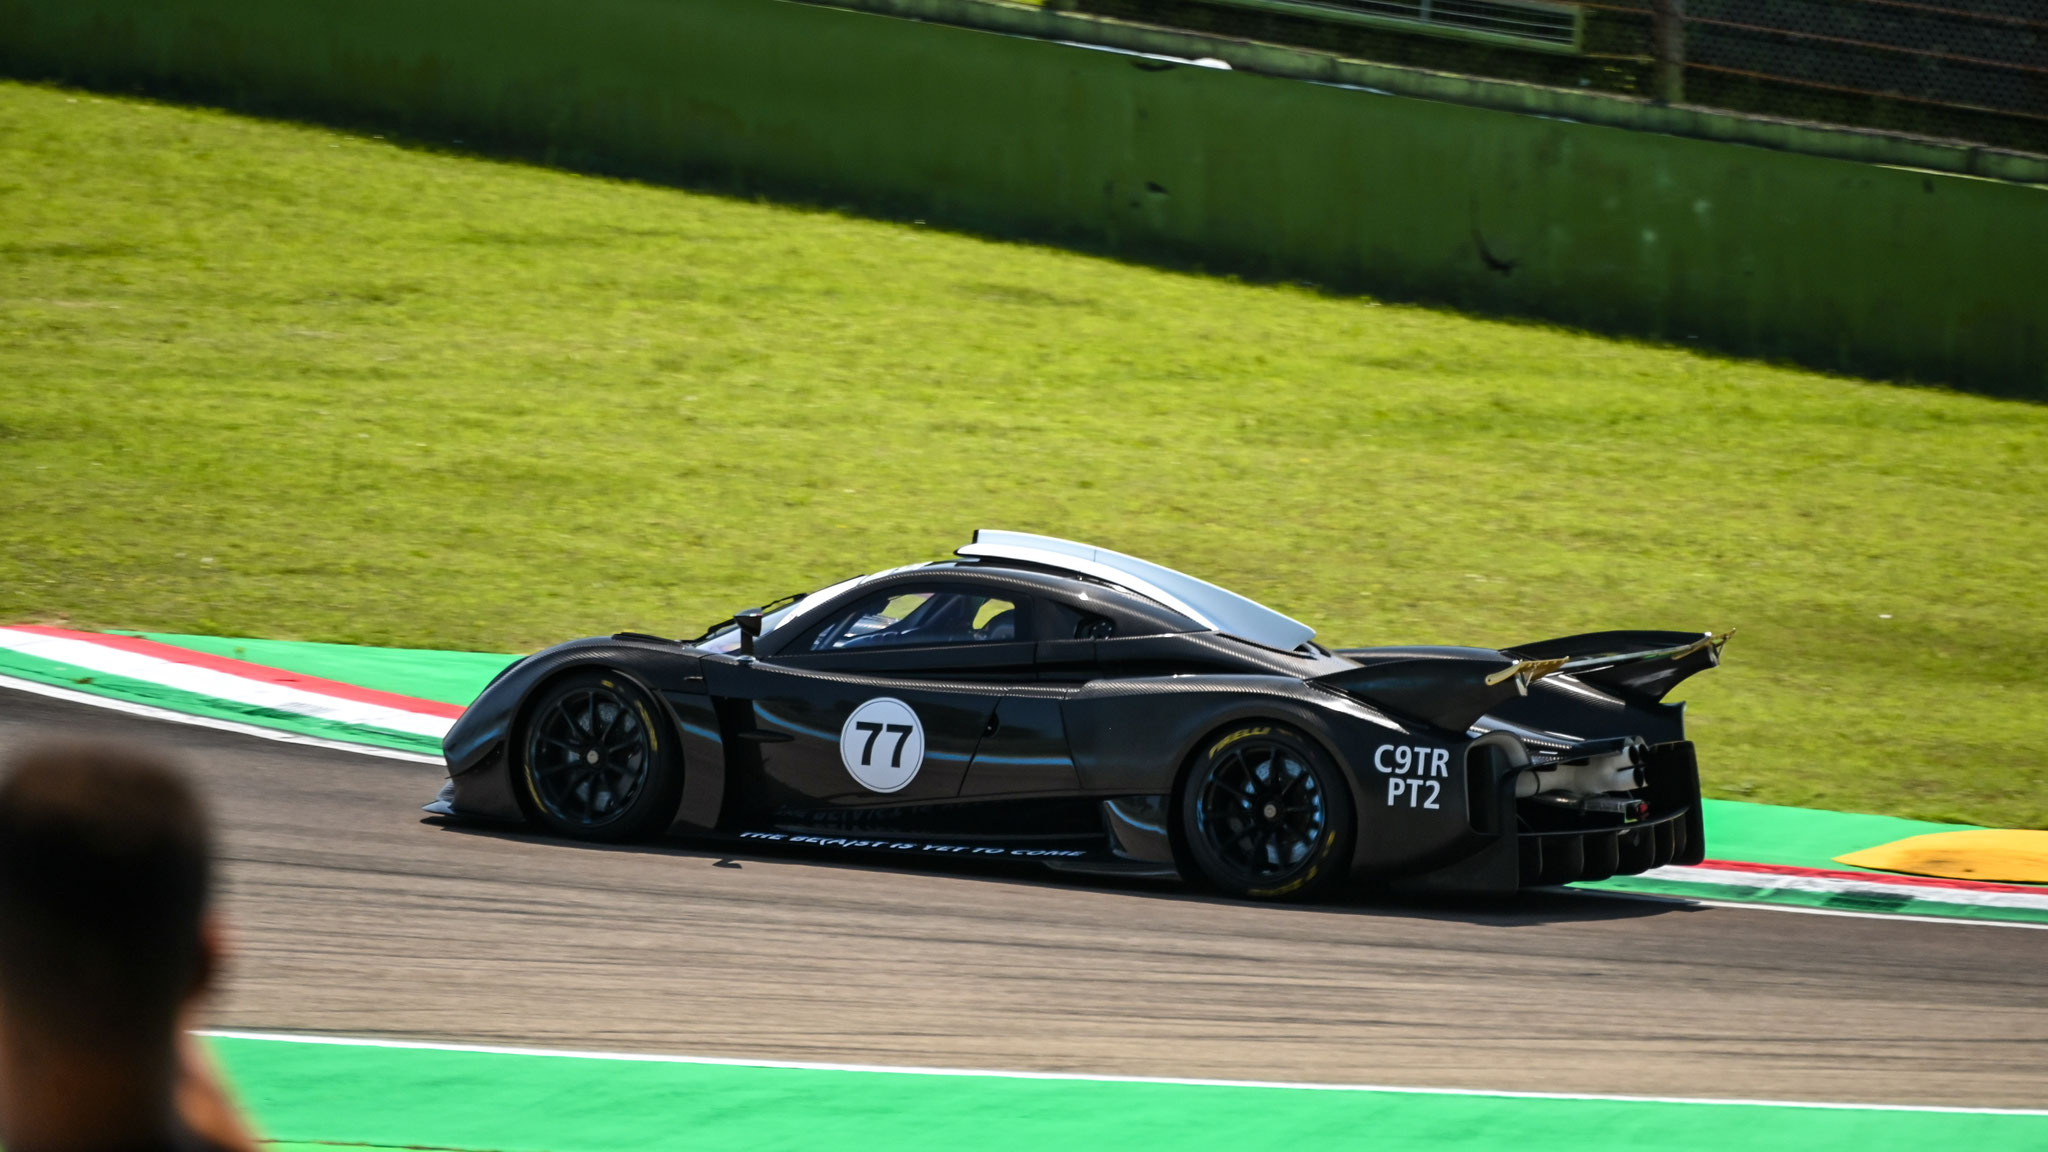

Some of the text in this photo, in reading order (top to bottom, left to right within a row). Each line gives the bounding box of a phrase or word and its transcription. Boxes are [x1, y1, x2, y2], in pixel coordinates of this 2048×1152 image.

[856, 721, 914, 768] 77
[1374, 744, 1450, 777] C9TR
[1387, 778, 1441, 810] PT2
[740, 832, 787, 840] THE
[1011, 849, 1087, 857] COME
